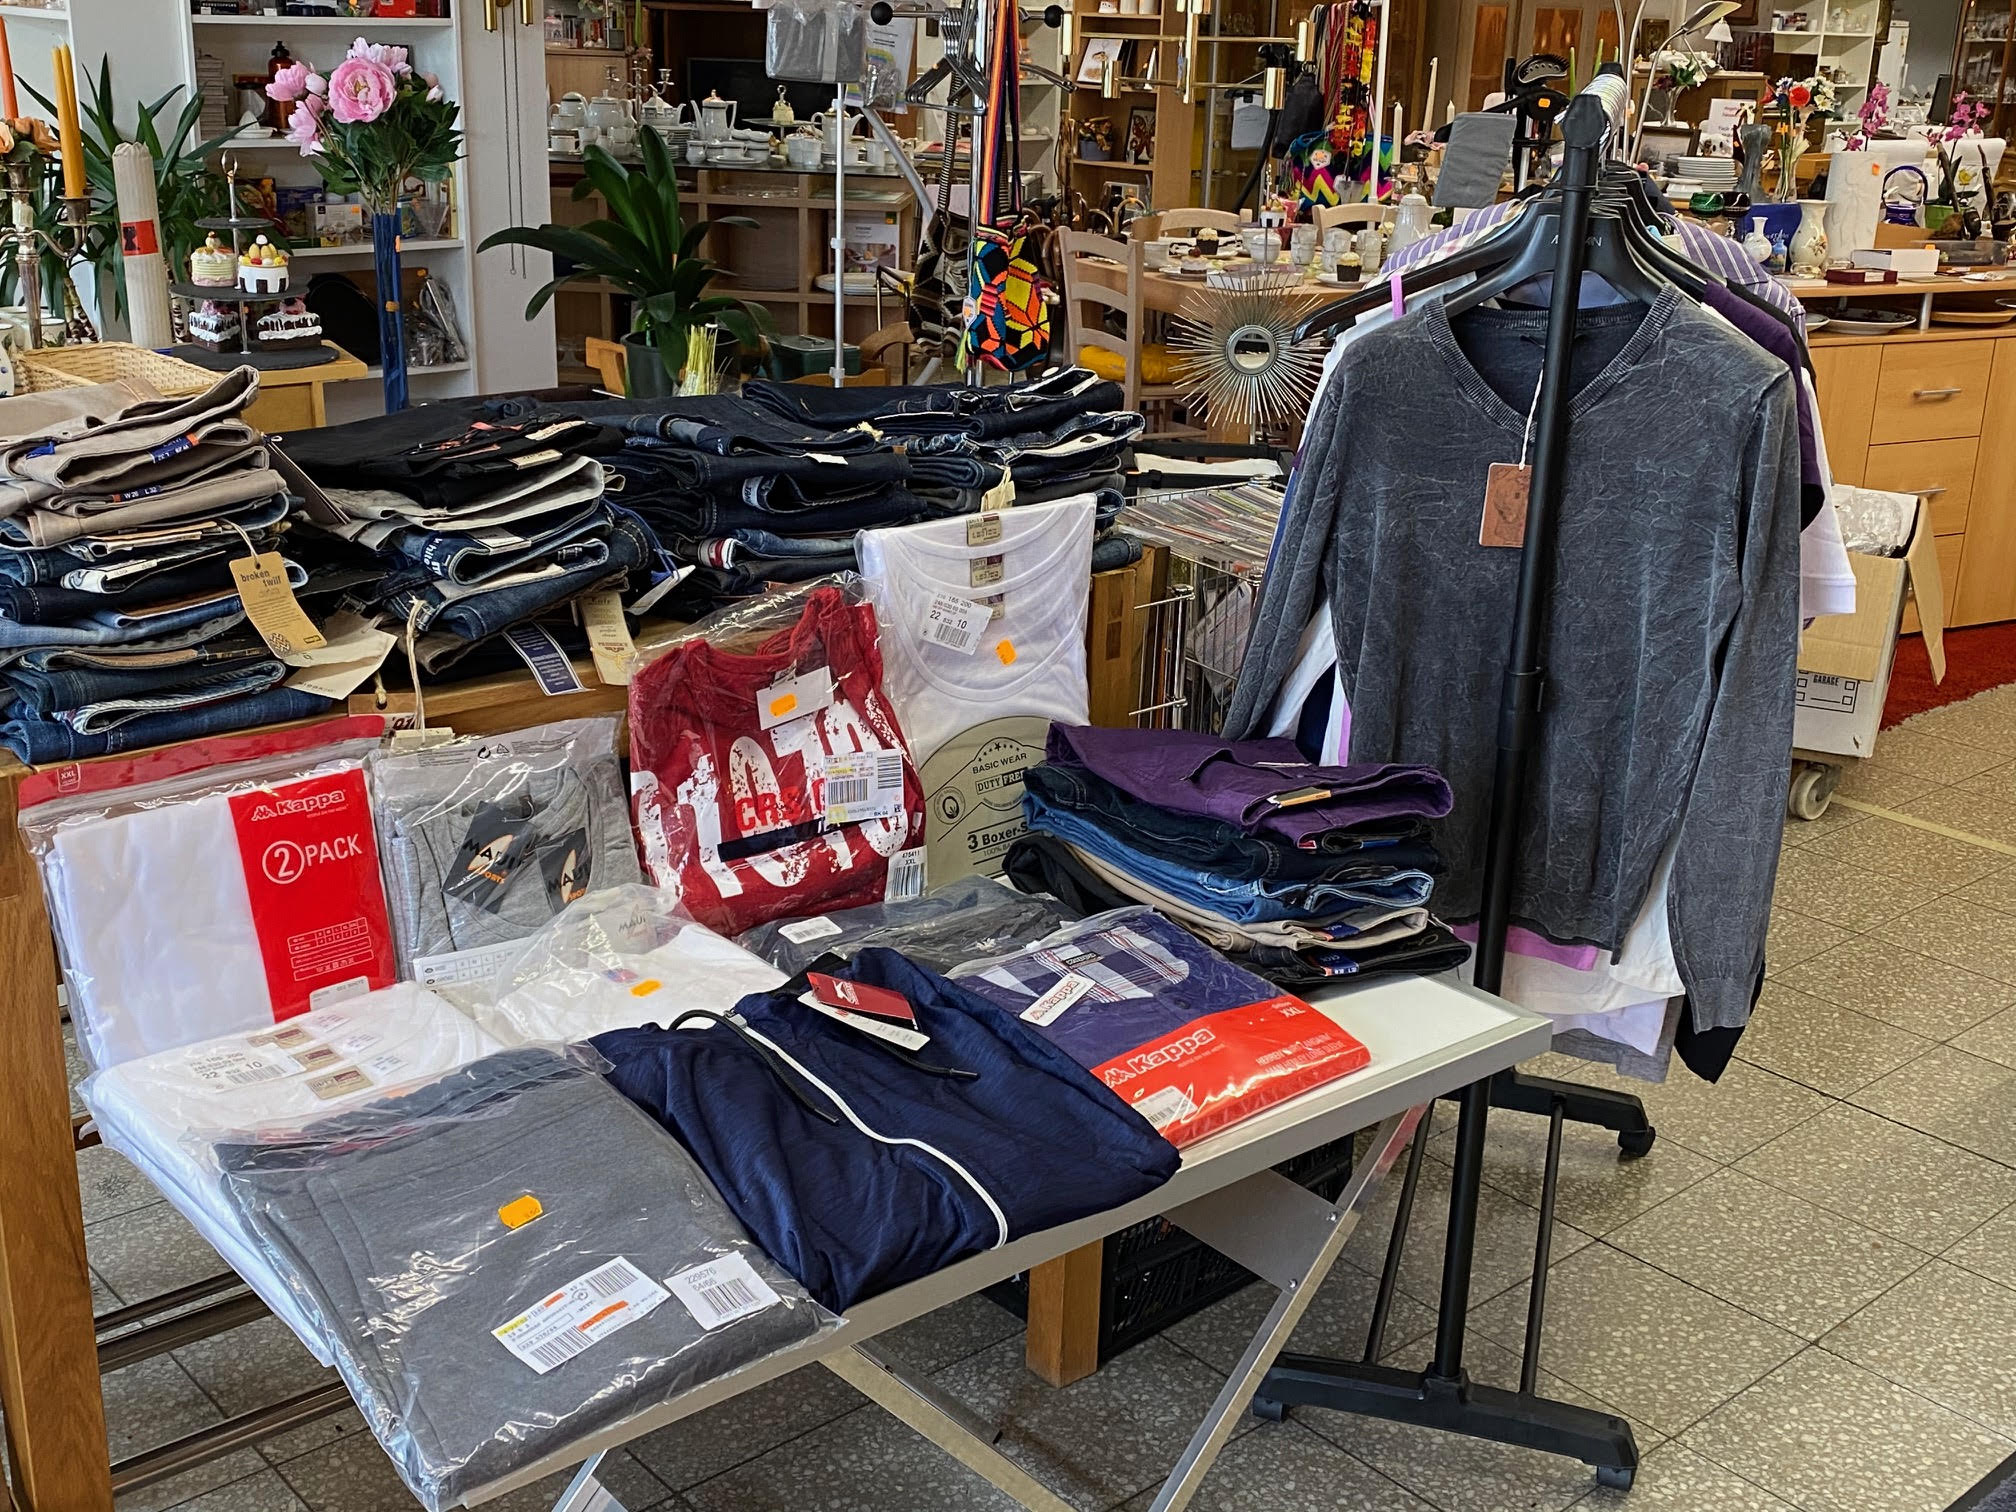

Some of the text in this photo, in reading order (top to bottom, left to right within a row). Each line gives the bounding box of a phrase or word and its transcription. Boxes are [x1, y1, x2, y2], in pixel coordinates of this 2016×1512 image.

[240, 570, 270, 582] broken
[929, 609, 941, 620] 22
[957, 619, 968, 629] 10
[1813, 674, 1840, 687] GARAGE
[972, 752, 1027, 775] BASIC WEAR
[61, 770, 76, 780] XXL
[977, 778, 1001, 793] DUTY
[276, 790, 345, 816] Kappa
[967, 833, 979, 850] 3
[273, 833, 363, 879] 2 PACK
[1039, 981, 1080, 1014] Kappa
[1279, 1006, 1306, 1018] XXL
[1127, 1028, 1216, 1074] Kappa
[246, 1060, 263, 1070] 10
